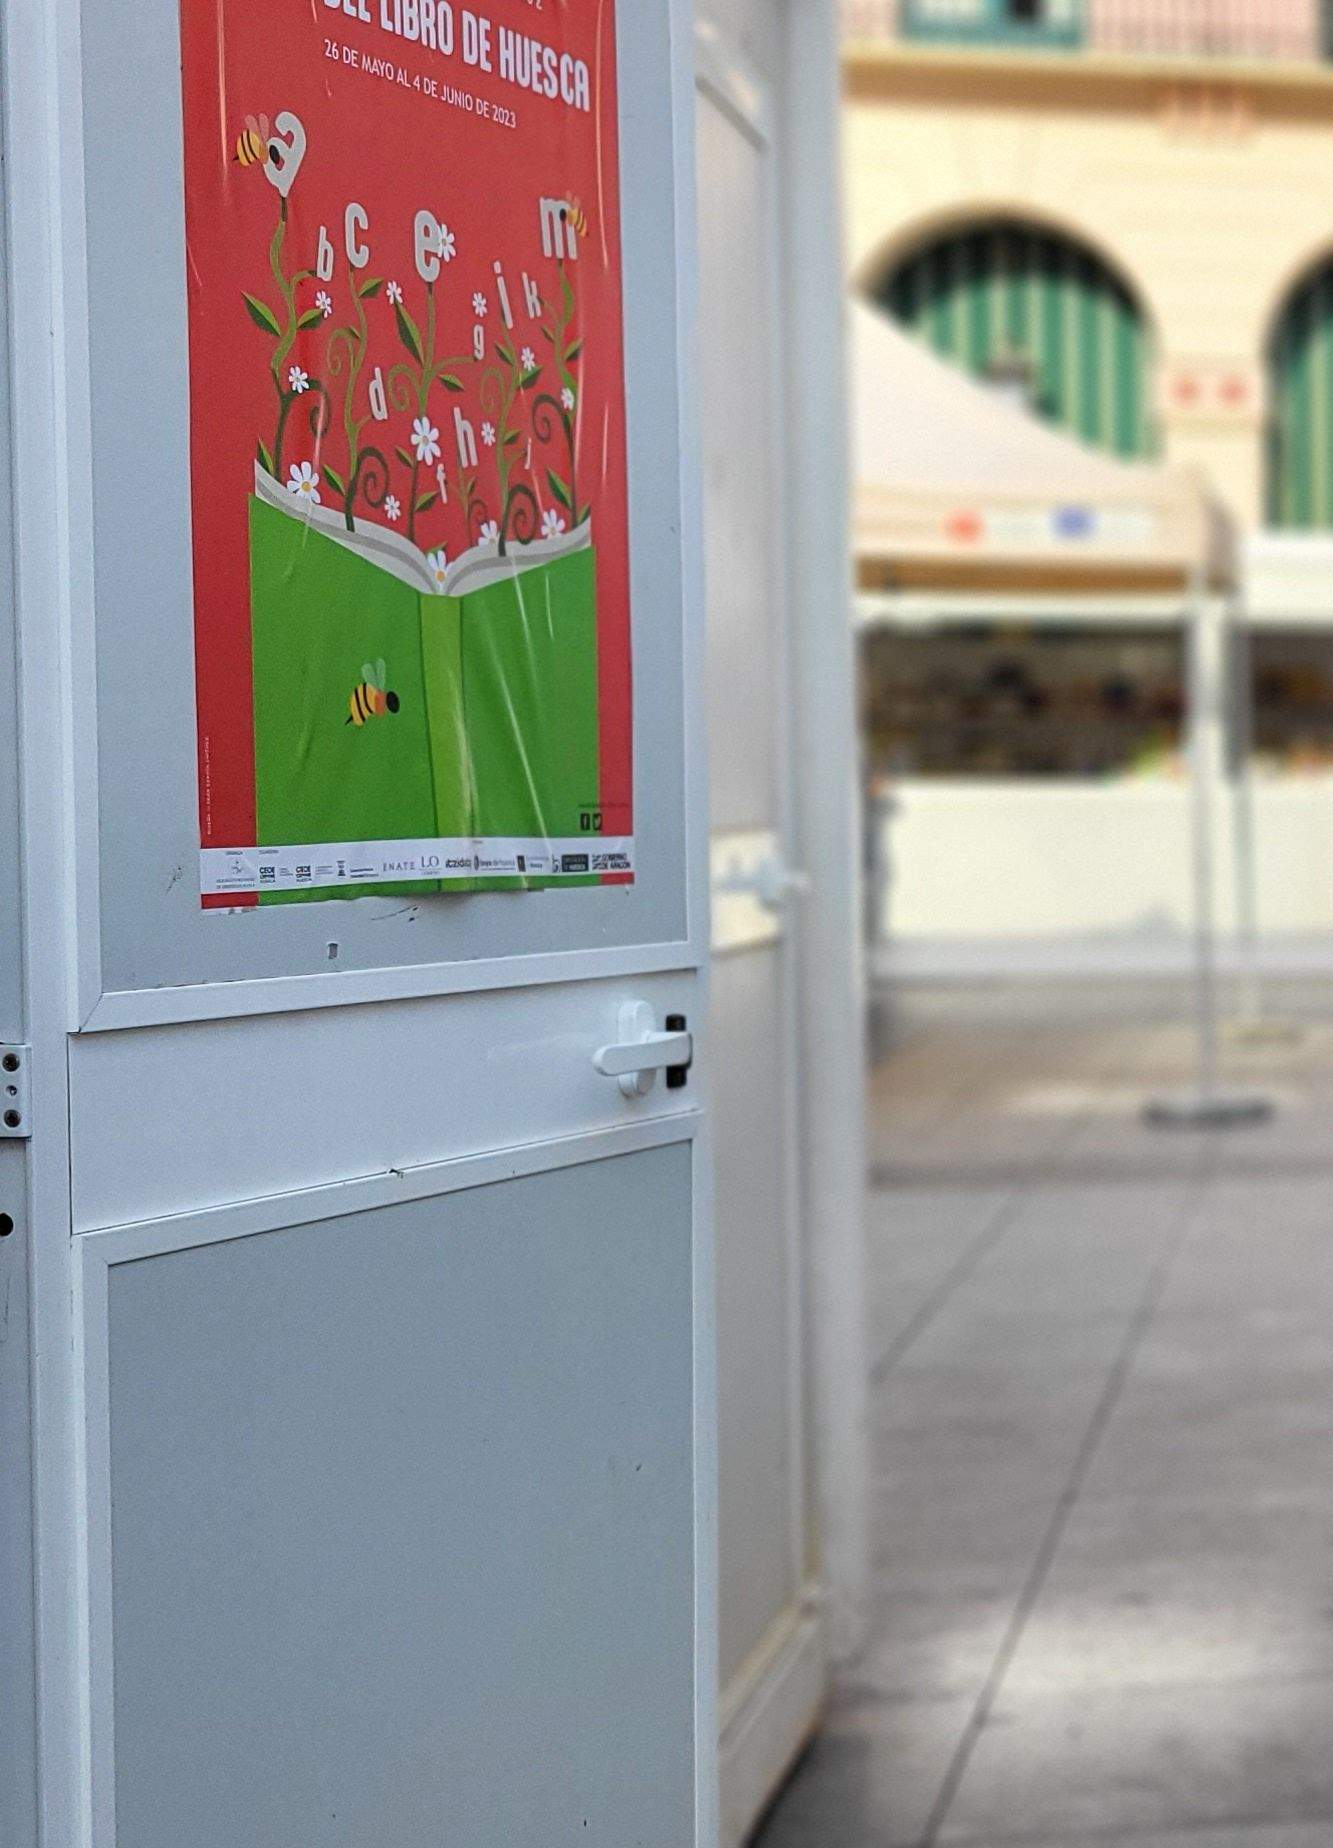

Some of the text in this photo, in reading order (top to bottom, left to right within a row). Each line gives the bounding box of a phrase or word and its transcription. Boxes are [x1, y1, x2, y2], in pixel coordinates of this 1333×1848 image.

[324, 39, 517, 129] 26 DE MAYO AL 4 DE JUNIO DE 2023
[380, 0, 590, 112] LIBRO DE HUESCA
[317, 225, 334, 281] b
[414, 210, 441, 282] e
[540, 196, 577, 260] m
[522, 272, 542, 319] k
[473, 324, 484, 360] g
[369, 367, 388, 420] d
[454, 406, 478, 468] h
